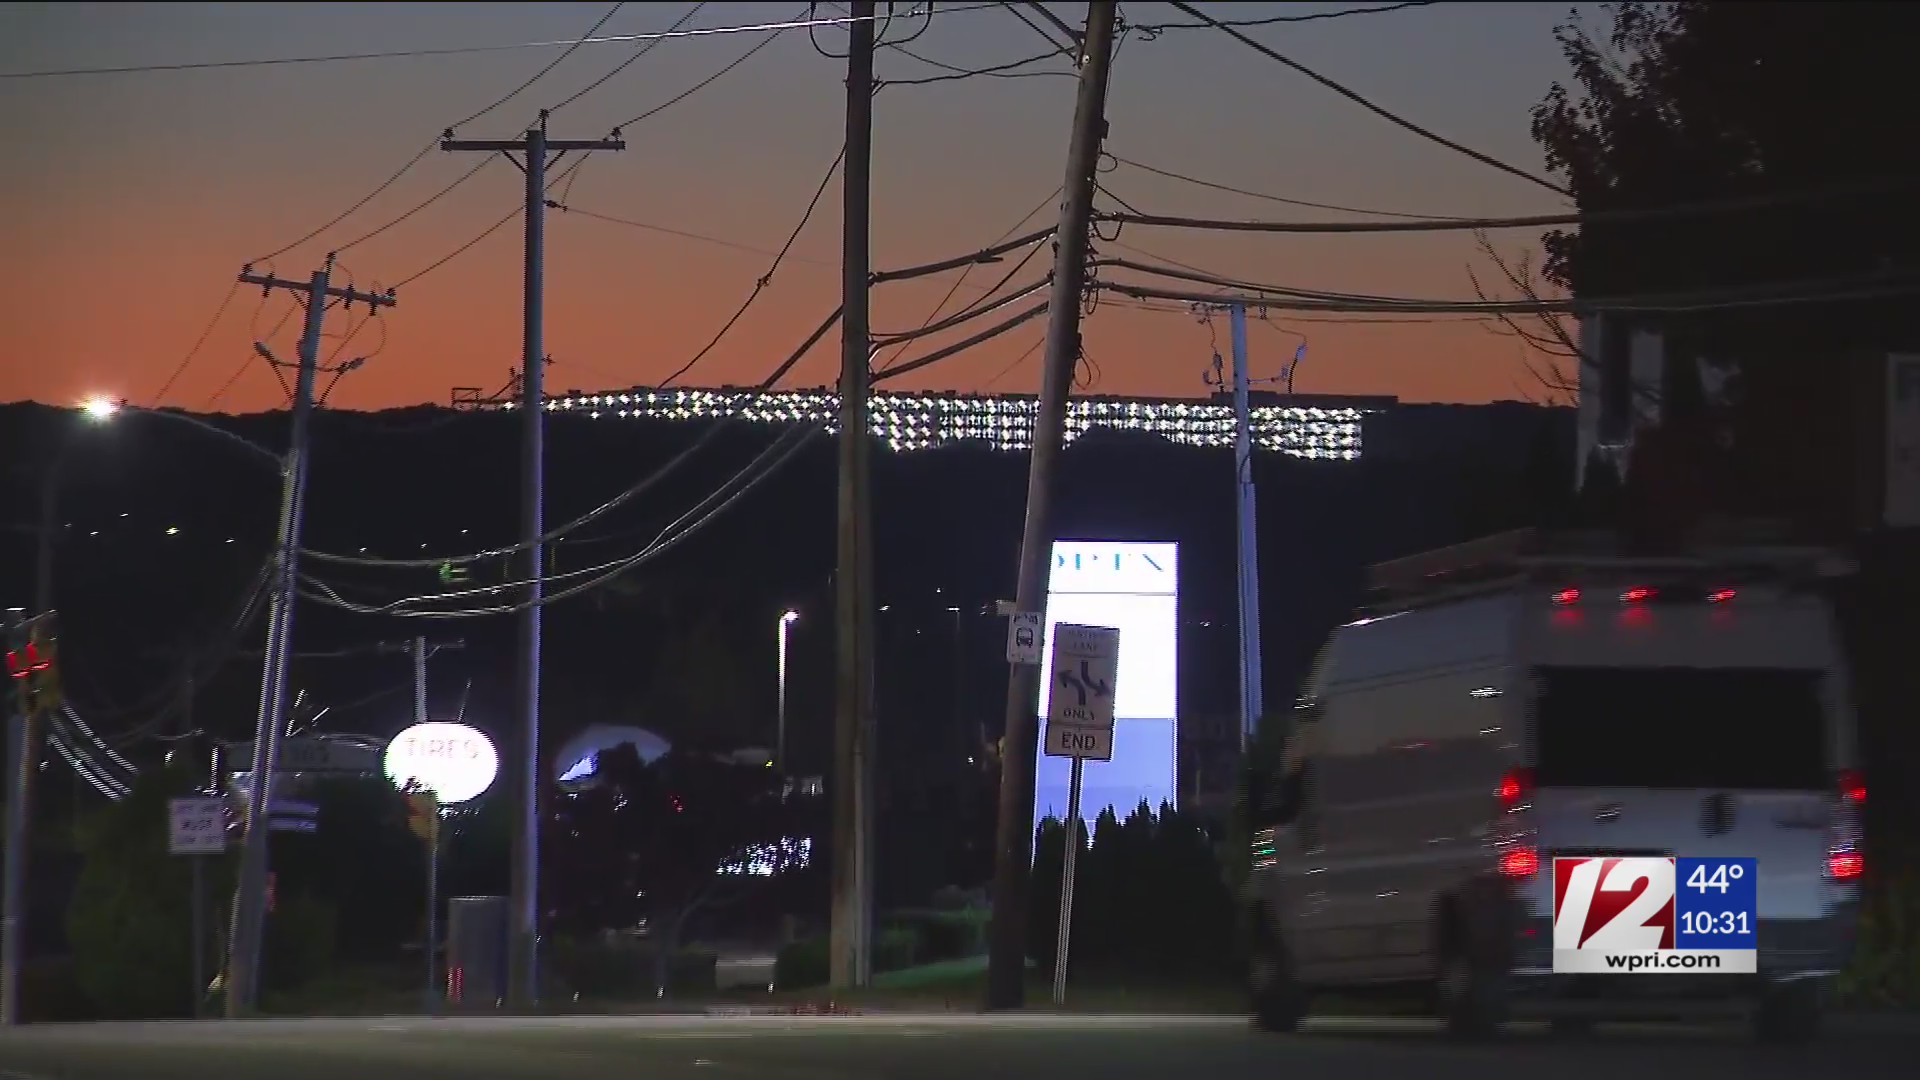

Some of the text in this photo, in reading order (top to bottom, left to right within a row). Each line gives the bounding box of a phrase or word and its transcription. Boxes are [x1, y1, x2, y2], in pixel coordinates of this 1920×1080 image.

[1063, 707, 1096, 721] ONLY
[404, 737, 480, 758] TIRES
[1061, 731, 1096, 751] END
